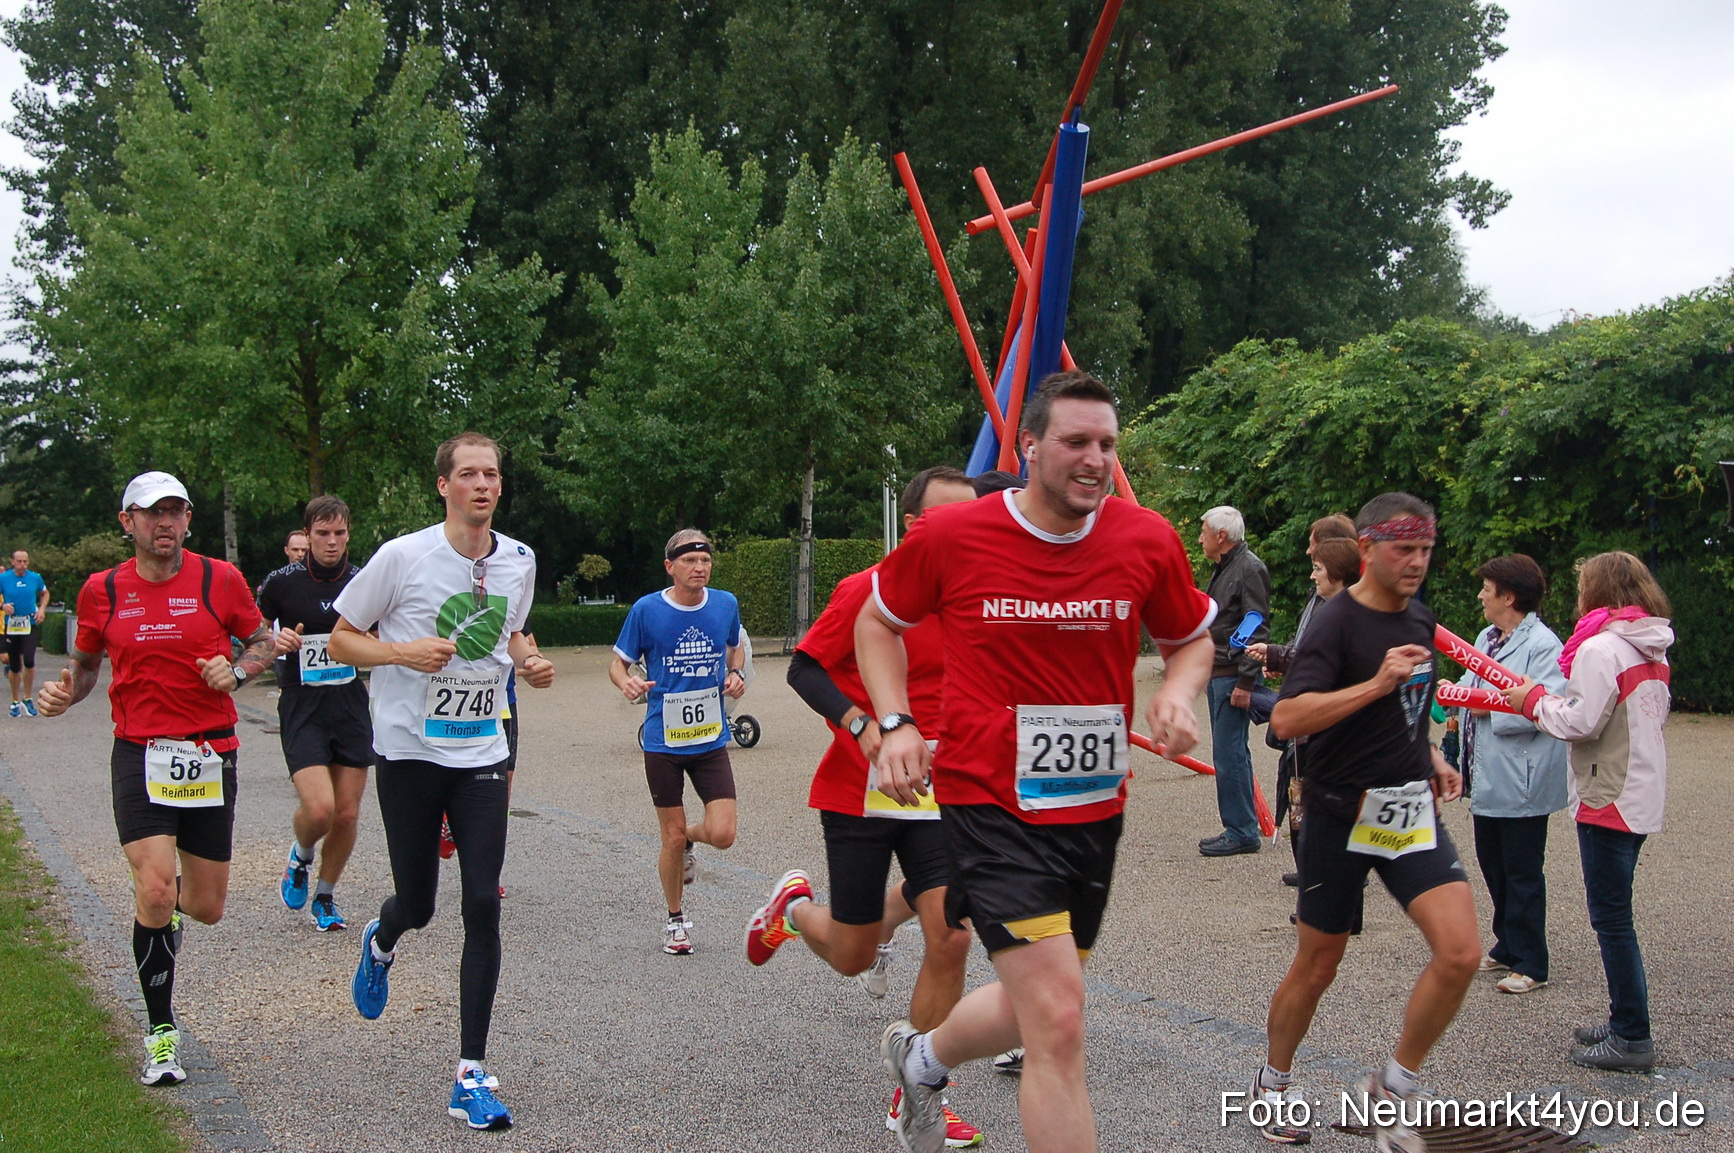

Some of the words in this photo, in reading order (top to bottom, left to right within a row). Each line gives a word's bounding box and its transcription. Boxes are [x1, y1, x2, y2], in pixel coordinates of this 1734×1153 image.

[982, 598, 1112, 619] NEUMARKT
[139, 623, 176, 632] Gruber
[662, 656, 677, 667] 13.
[1446, 640, 1483, 672] BKK
[430, 675, 459, 685] PARTL
[461, 678, 494, 686] Neumarkt
[434, 688, 494, 717] 2748
[684, 694, 710, 703] Neumarkt
[682, 703, 705, 725] 66
[1021, 716, 1060, 727] PARTL
[1062, 715, 1112, 727] Neumarkt
[445, 723, 482, 736] Thomas
[670, 726, 718, 740] Hans-Jürgen
[148, 744, 175, 754] PARTL
[1031, 731, 1115, 772] 2381
[170, 755, 202, 781] 58
[161, 786, 206, 798] Reinhard
